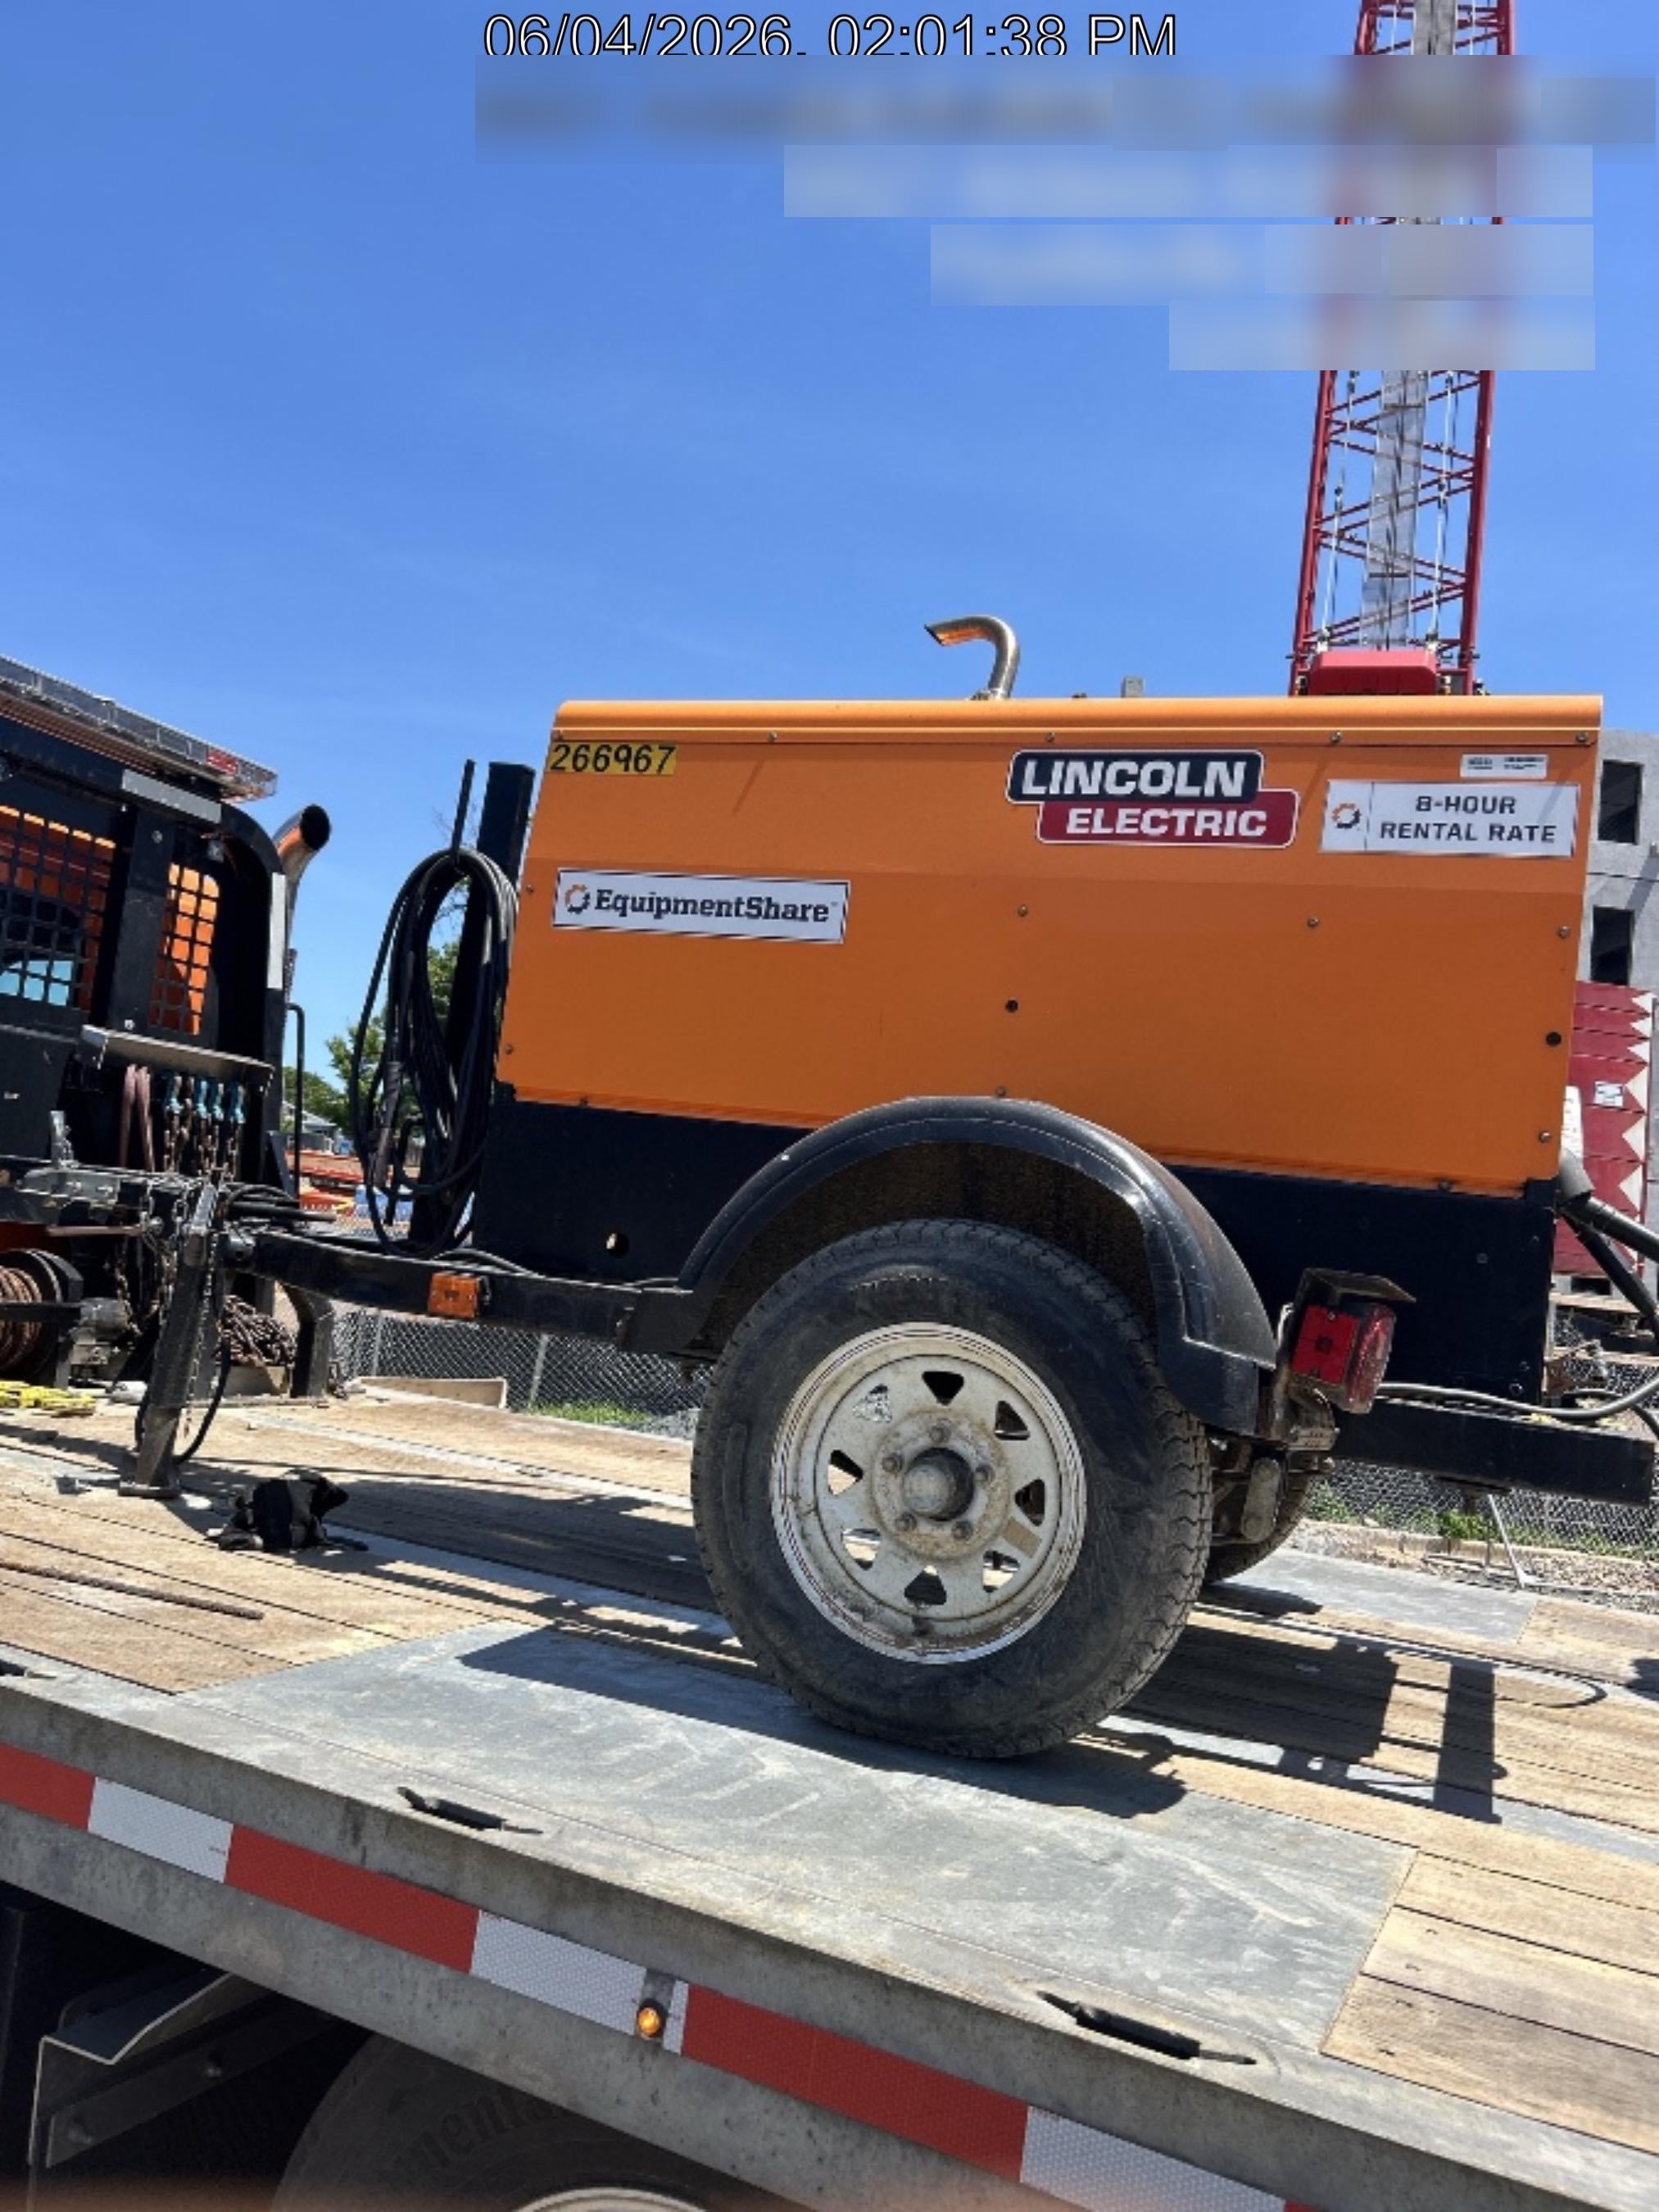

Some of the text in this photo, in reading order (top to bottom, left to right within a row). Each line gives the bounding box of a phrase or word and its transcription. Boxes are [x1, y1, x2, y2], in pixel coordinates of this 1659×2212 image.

[550, 744, 677, 773] 266967
[1022, 759, 1248, 797] LINCOLN
[1416, 796, 1516, 814] 8-HOUR
[1066, 807, 1268, 836] ELECTRIC
[1380, 822, 1557, 843] RENTAL RATE
[593, 888, 830, 922] EquipmentShare
